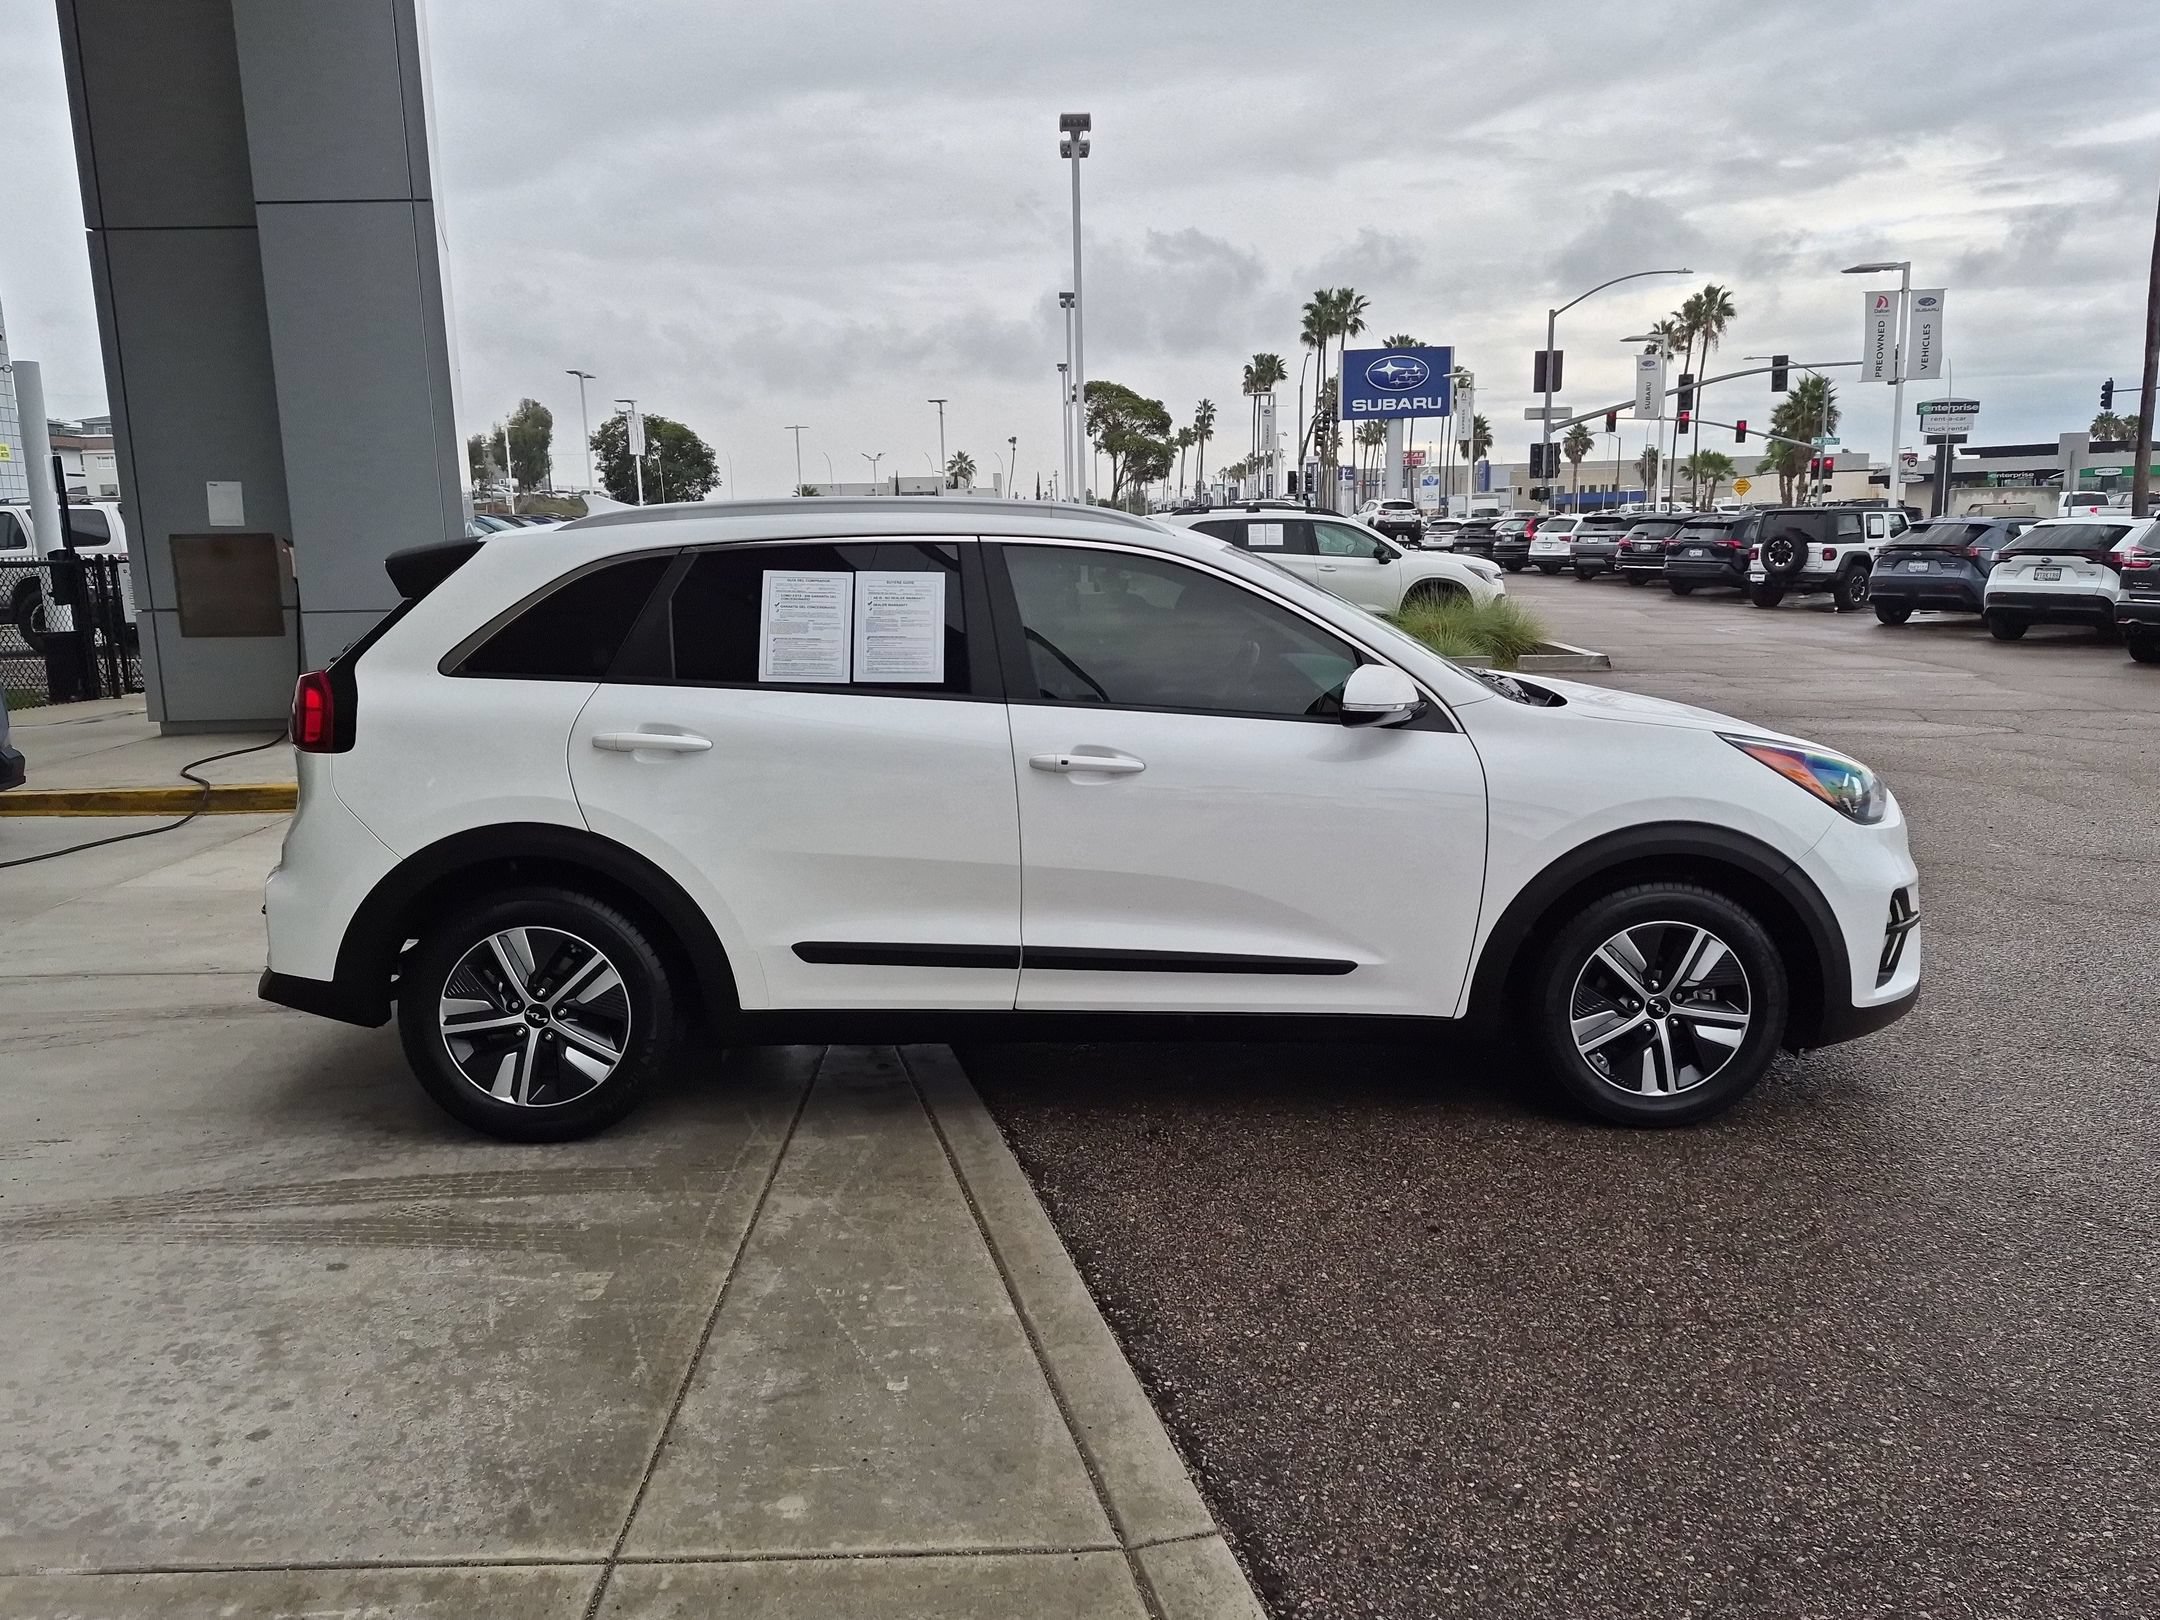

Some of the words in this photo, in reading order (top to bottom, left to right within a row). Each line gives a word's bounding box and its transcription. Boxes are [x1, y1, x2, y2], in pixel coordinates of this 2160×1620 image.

[1875, 320, 1886, 378] PREOWNED
[1920, 323, 1931, 371] VEHICLES
[1352, 397, 1442, 412] SUBARU
[1923, 403, 1979, 412] enterprise
[1990, 471, 2034, 479] enterprise
